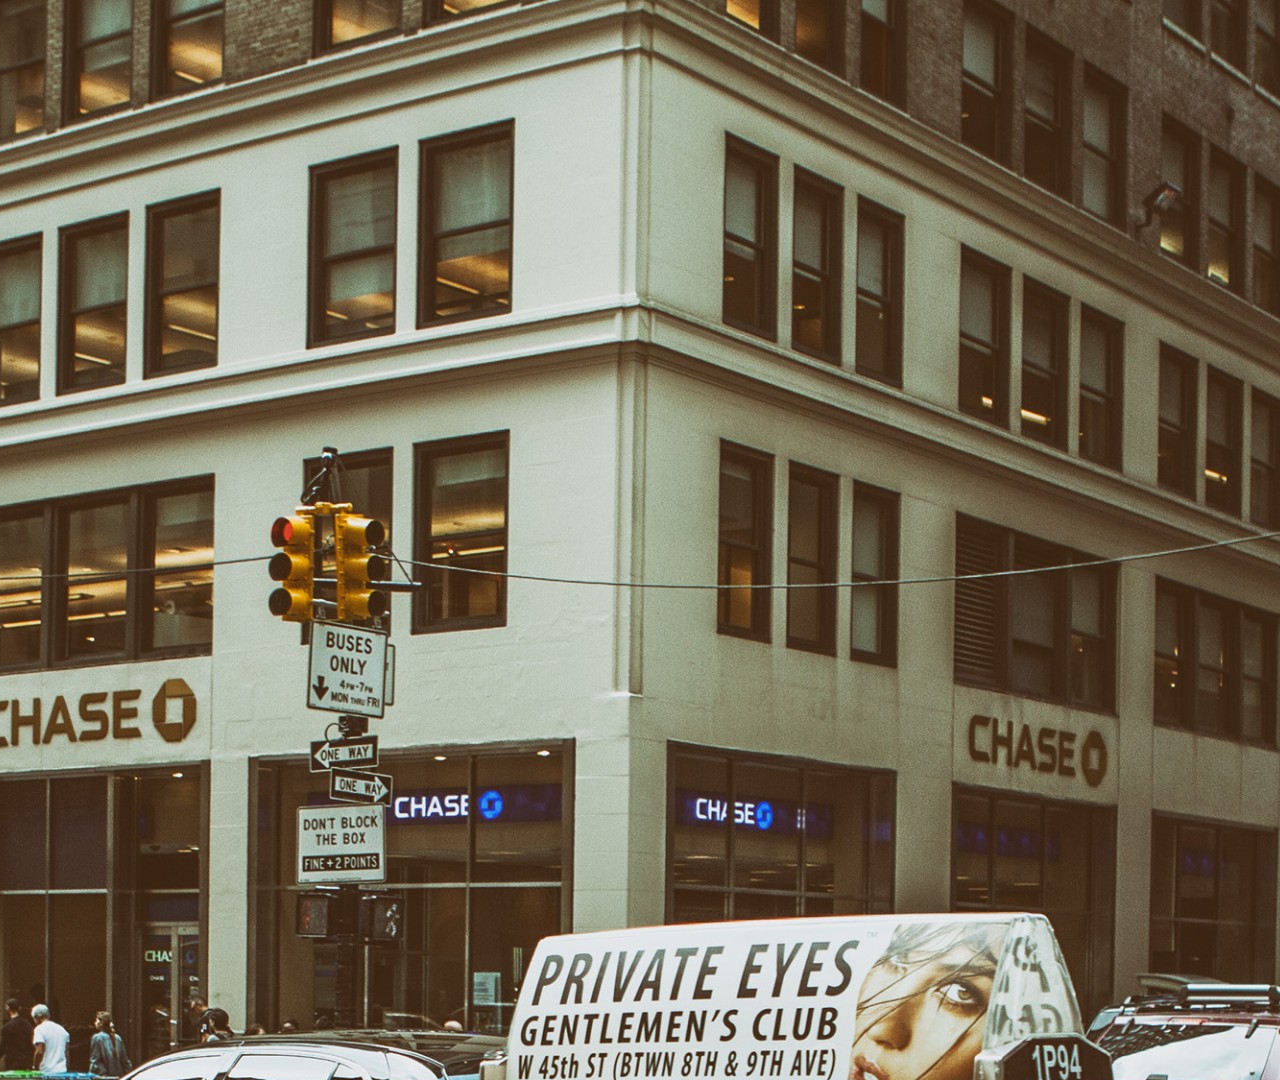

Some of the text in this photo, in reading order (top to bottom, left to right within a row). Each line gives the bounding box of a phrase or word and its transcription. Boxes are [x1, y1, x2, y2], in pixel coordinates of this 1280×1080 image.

[326, 631, 372, 655] BUSES
[330, 655, 367, 676] ONLY
[331, 691, 380, 708] MON THRU FRI
[320, 746, 370, 762] ONE WAY
[969, 714, 1077, 777] CHASE
[339, 778, 383, 796] ONE WAY
[394, 794, 469, 819] CHASE
[304, 815, 378, 831] DON'T BLOCK
[315, 832, 366, 846] THE BOX
[304, 858, 325, 870] FINE
[335, 857, 342, 869] 2
[344, 855, 378, 869] POINTS
[531, 940, 860, 1007] PRIVATE EYES
[520, 1007, 839, 1047] GENTLEMEN'S CLUB
[518, 1055, 533, 1080] W
[538, 1053, 579, 1079] 45th
[586, 1053, 608, 1078] ST
[681, 1050, 719, 1077] 8TH
[724, 1052, 739, 1077] &
[746, 1049, 784, 1076] 9TH
[789, 1049, 836, 1080] AVE)
